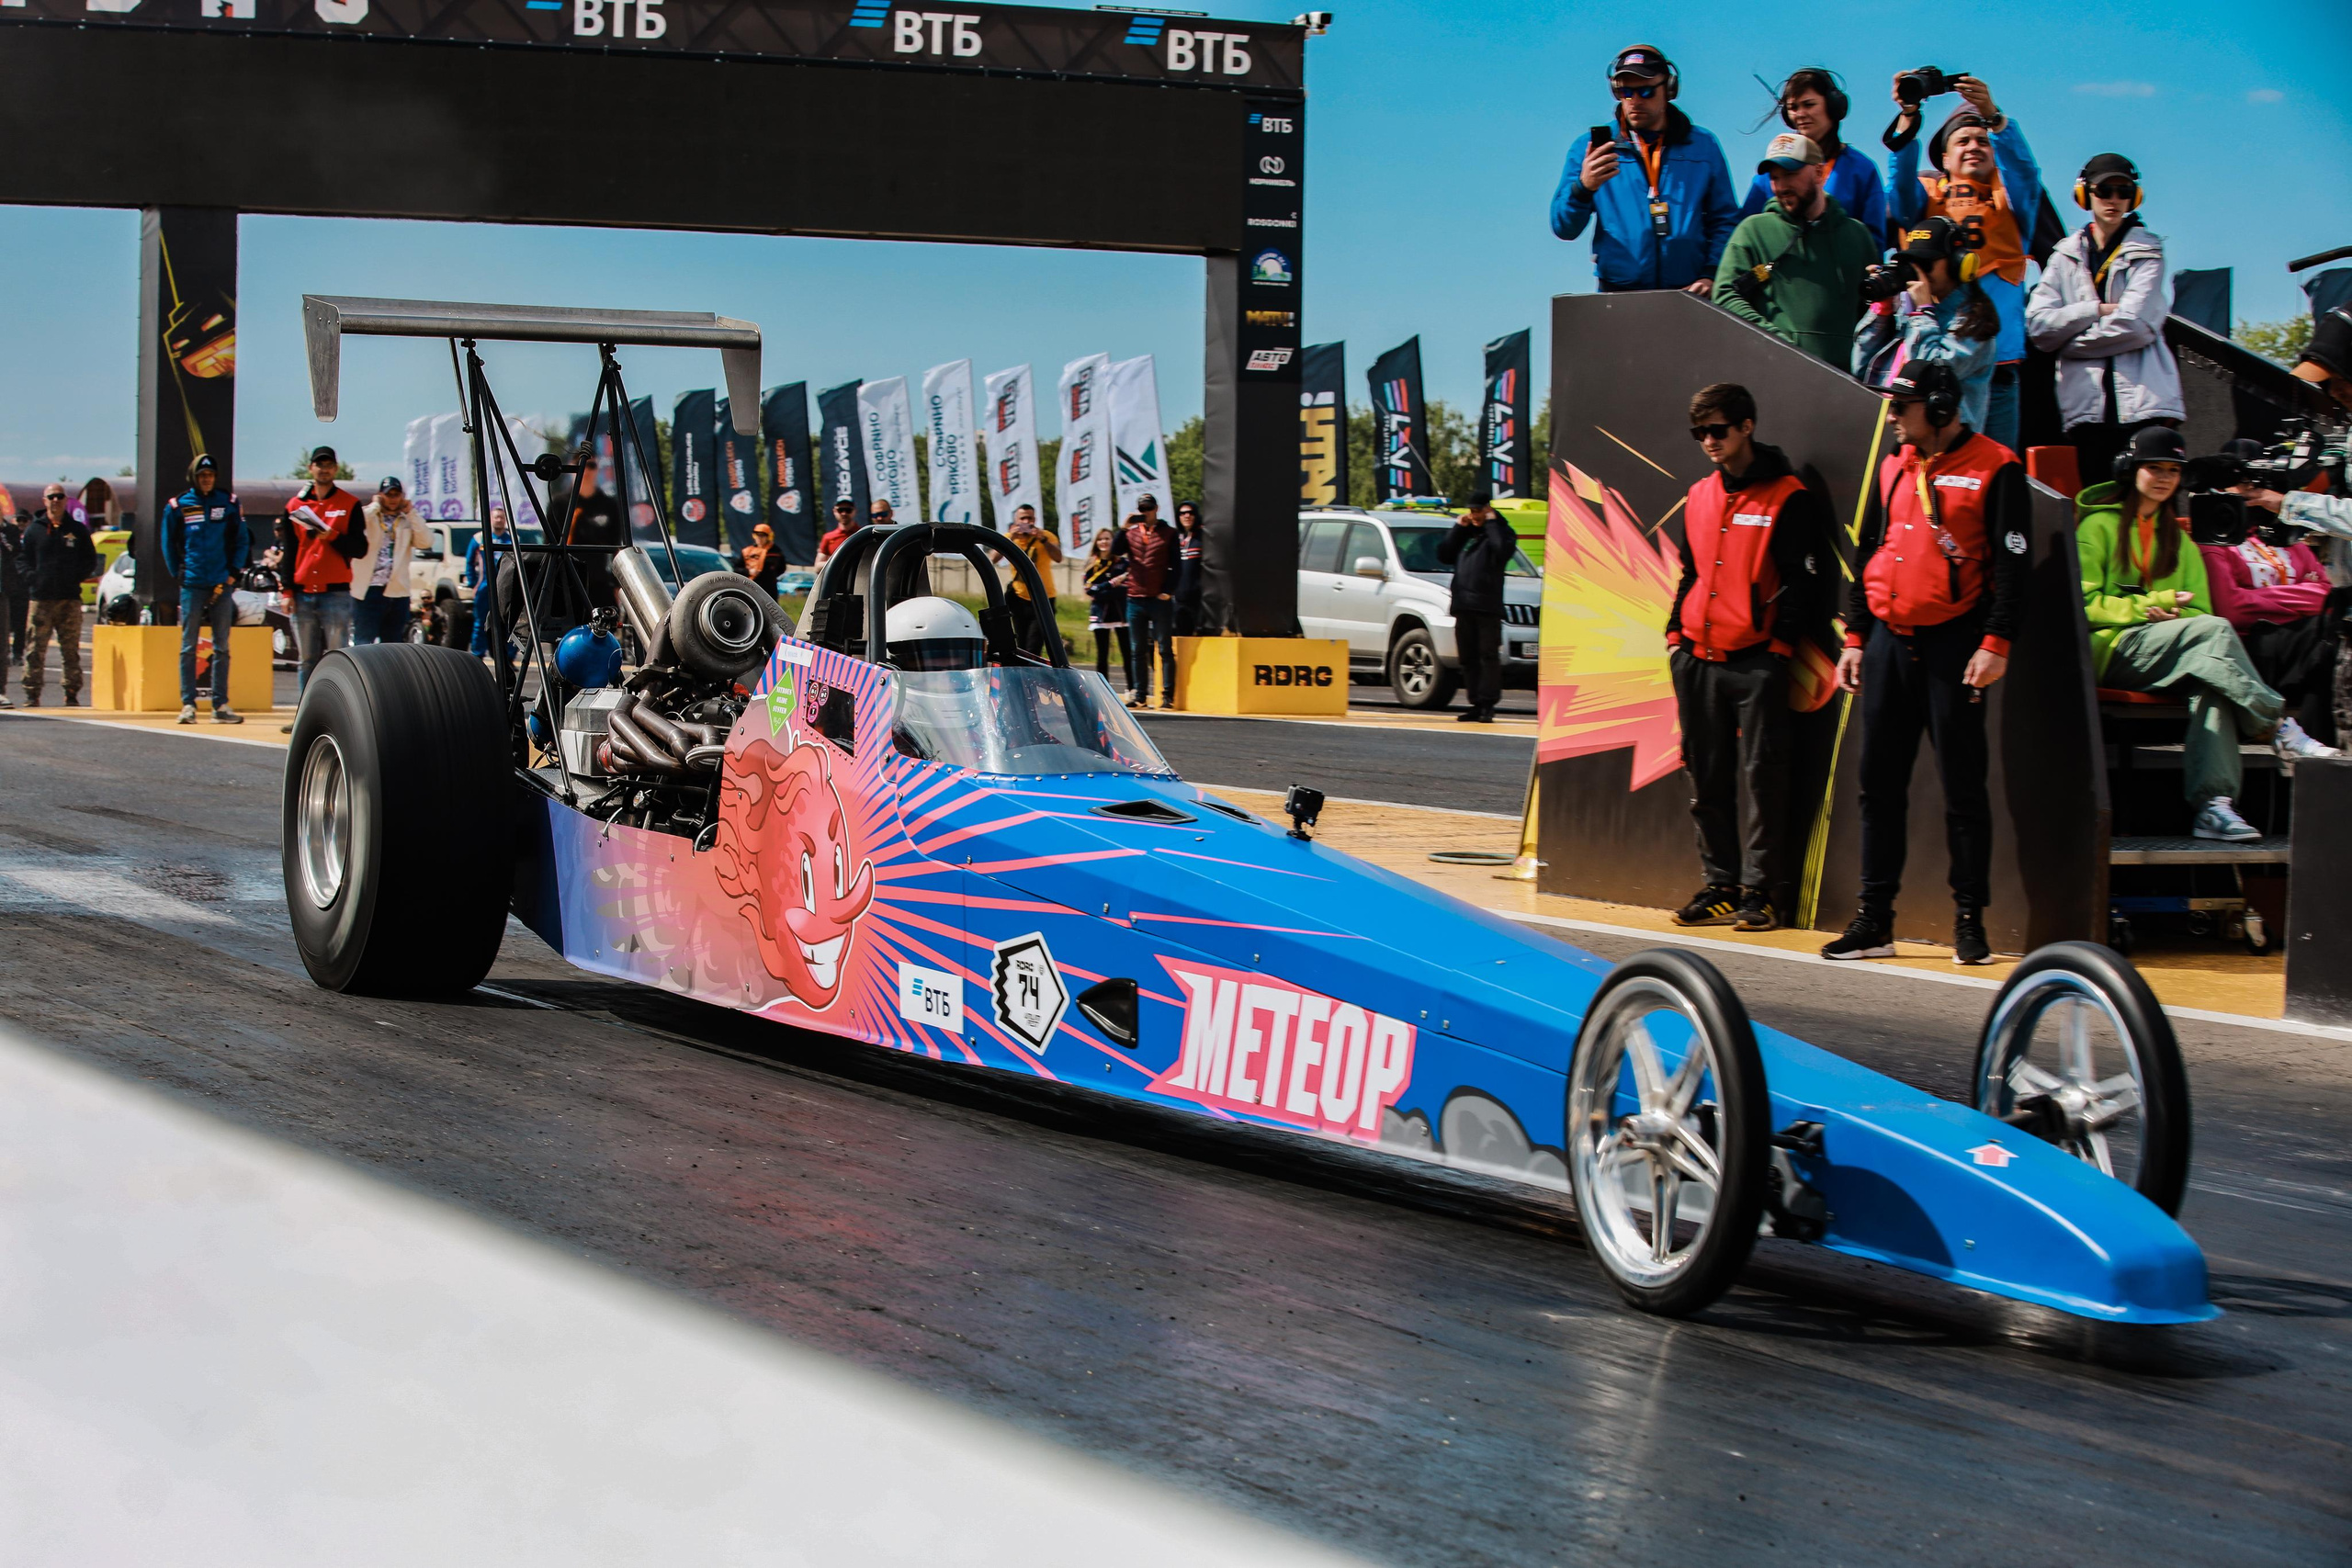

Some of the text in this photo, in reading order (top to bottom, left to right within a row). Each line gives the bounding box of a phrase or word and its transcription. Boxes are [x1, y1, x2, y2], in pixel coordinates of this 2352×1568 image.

[574, 0, 667, 39] ВТБ
[894, 11, 983, 57] ВТБ
[1167, 28, 1251, 75] ВТБ
[1261, 118, 1293, 133] ВТБ
[1253, 664, 1333, 686] RDRC
[925, 987, 950, 1018] ВТБ
[1019, 974, 1040, 1010] 74
[1166, 969, 1411, 1132] МЕТЕОР
